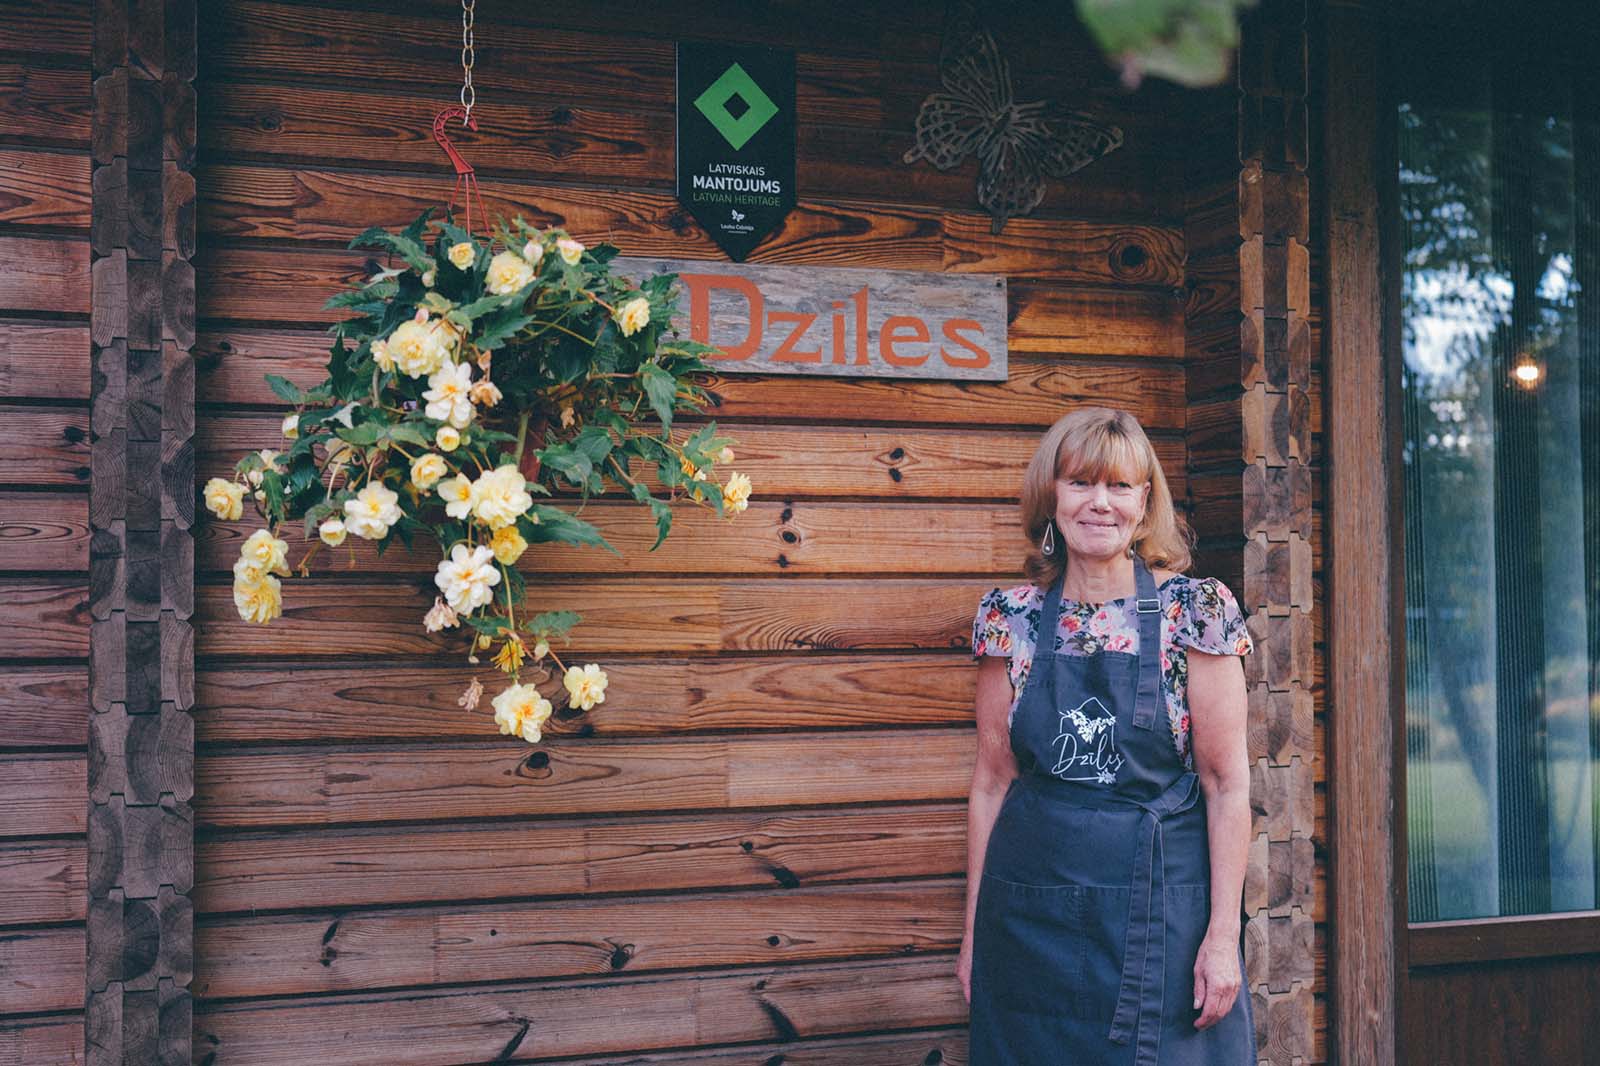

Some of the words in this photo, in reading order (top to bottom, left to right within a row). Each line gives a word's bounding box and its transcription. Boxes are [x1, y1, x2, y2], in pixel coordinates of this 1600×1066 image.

[709, 163, 765, 176] LATVISKAIS
[693, 175, 780, 194] MANTOJUMS
[693, 192, 732, 203] LATVIAN
[734, 194, 780, 206] HERITAGE
